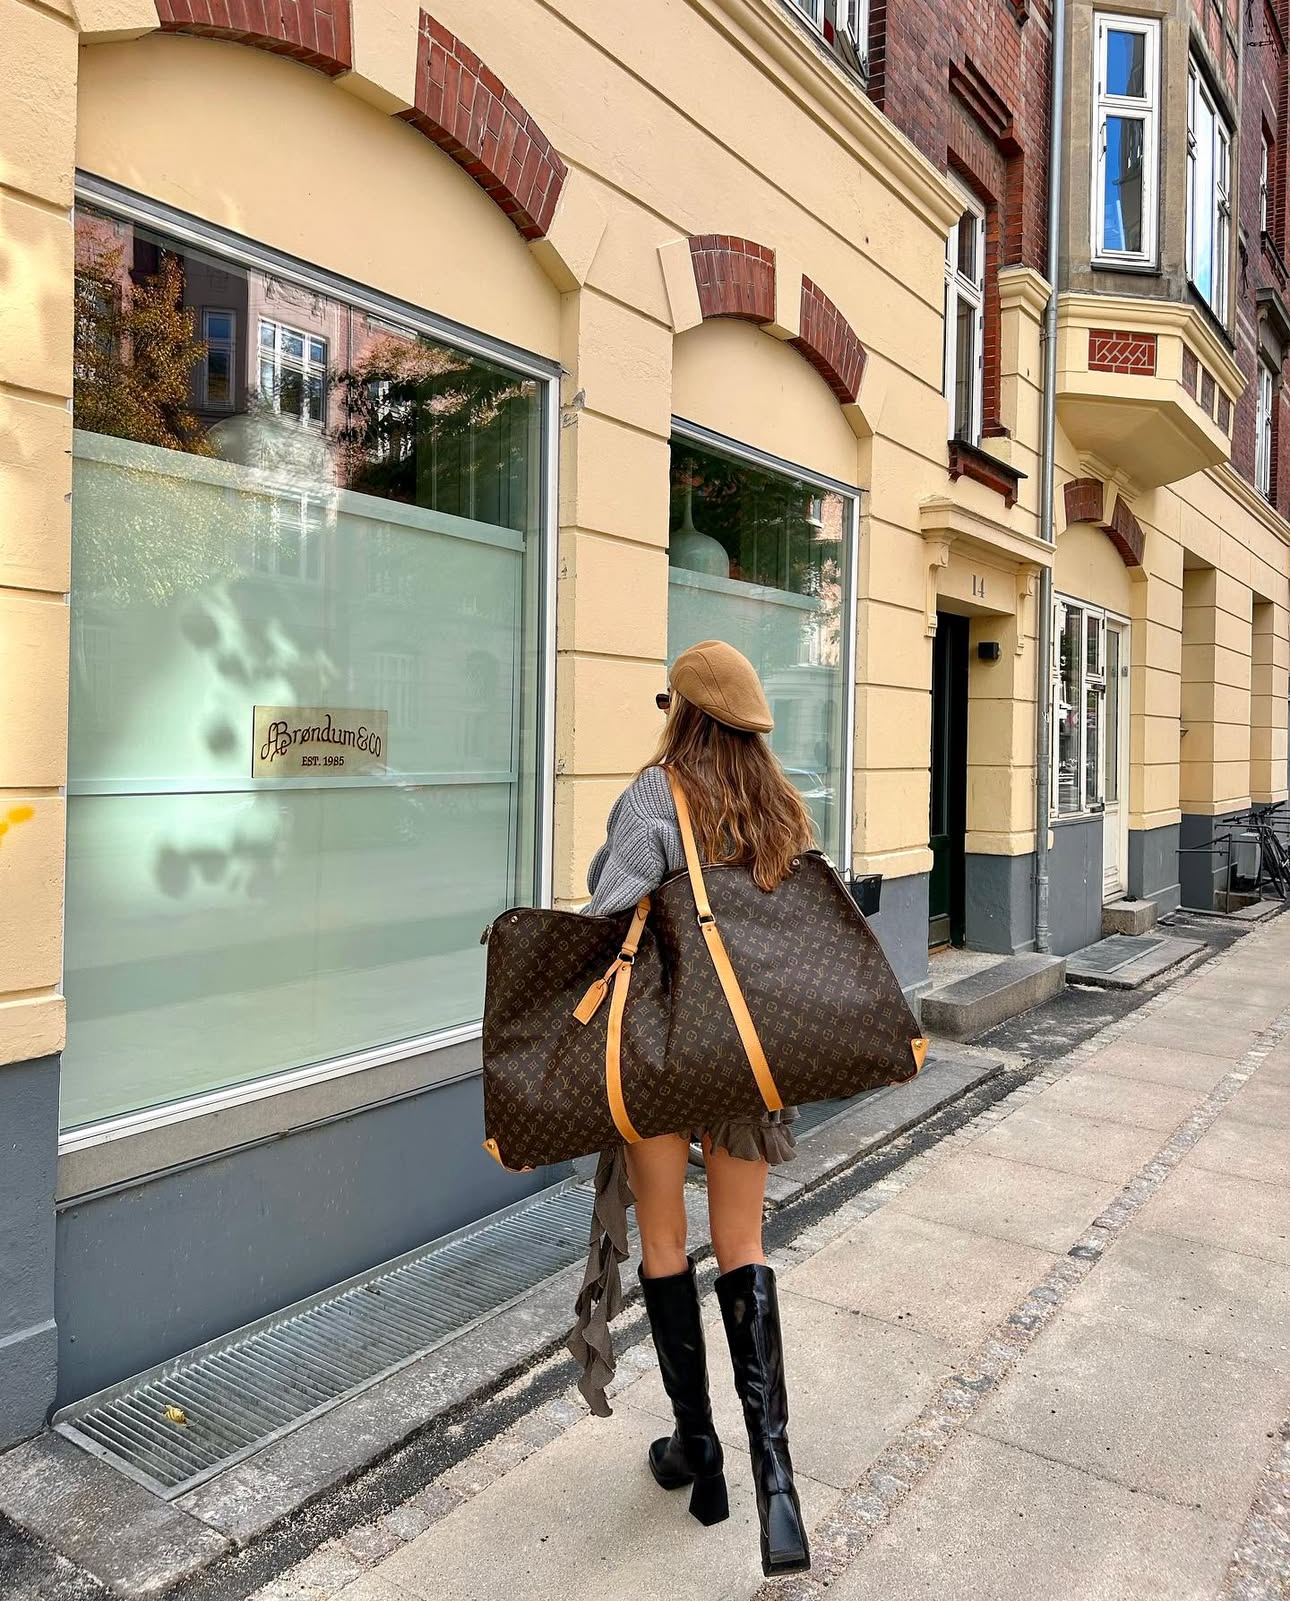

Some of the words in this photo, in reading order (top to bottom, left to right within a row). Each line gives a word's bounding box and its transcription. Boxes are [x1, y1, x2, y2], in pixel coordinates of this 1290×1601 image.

[972, 575, 985, 598] 14
[302, 756, 320, 766] EST.
[323, 756, 344, 766] 1985
